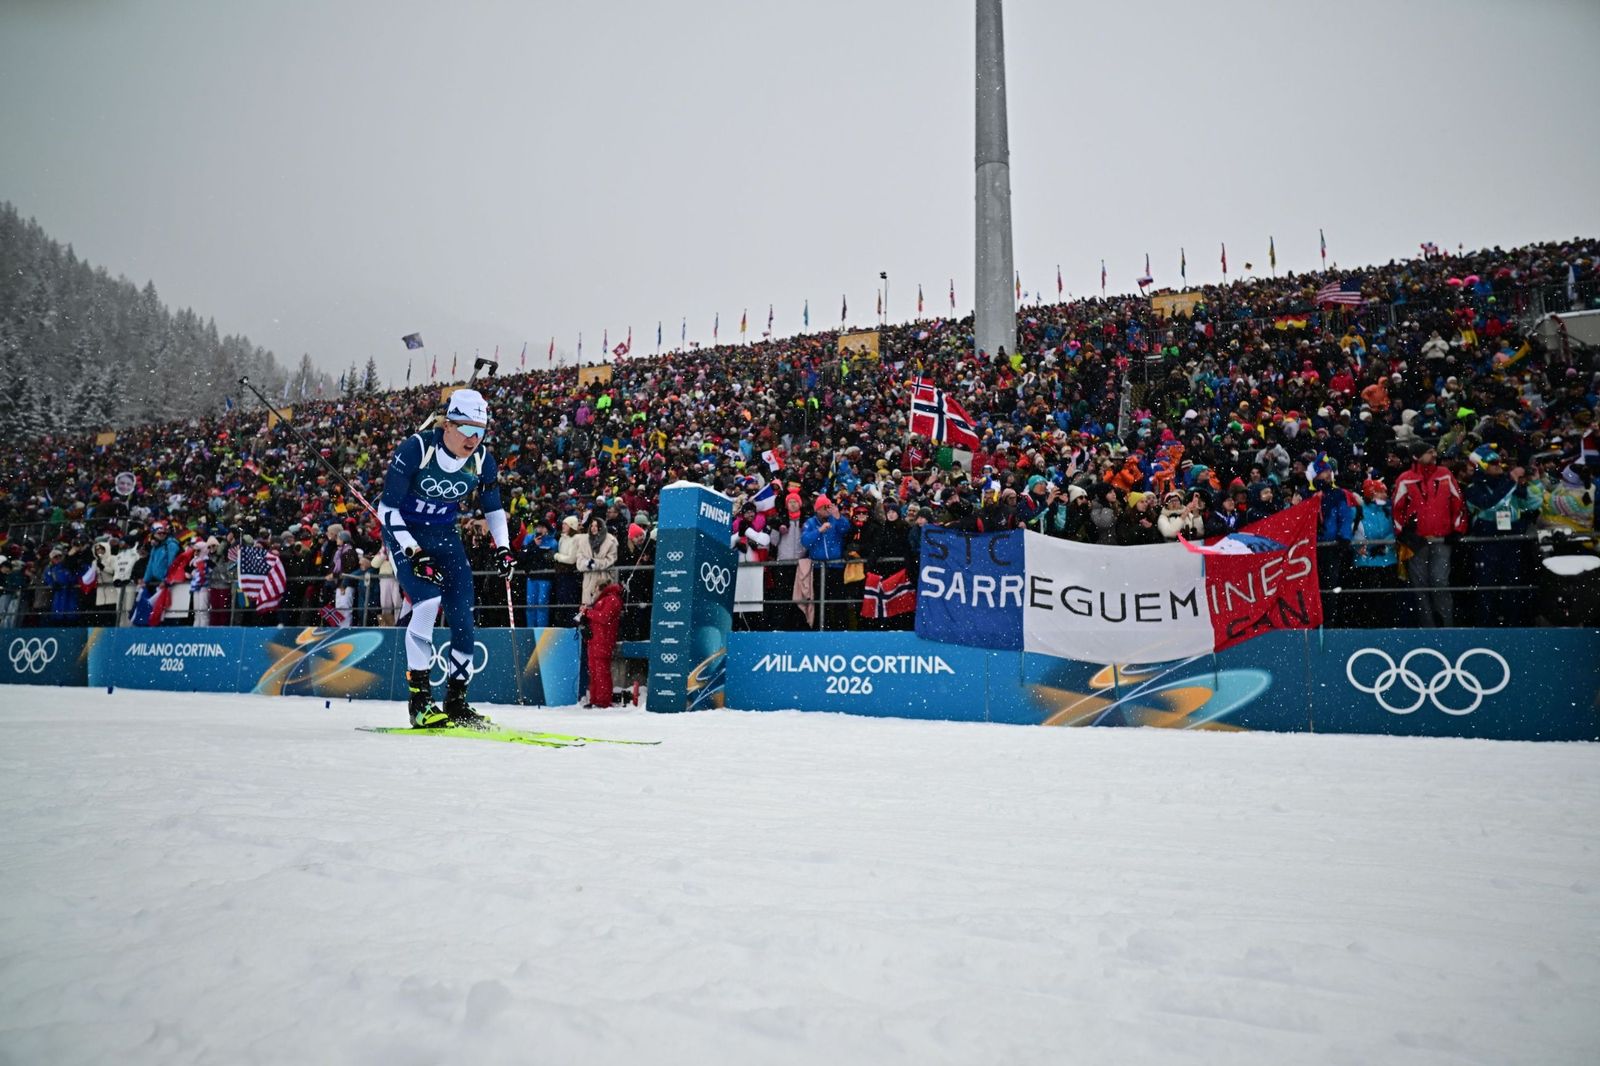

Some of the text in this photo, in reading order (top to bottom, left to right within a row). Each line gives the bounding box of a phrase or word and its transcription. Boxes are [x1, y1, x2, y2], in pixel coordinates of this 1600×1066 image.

[700, 502, 730, 525] FINISH
[924, 529, 1012, 567] STC
[920, 538, 1312, 622] SARREGUEMINES
[125, 642, 226, 657] MILANO CORTINA
[160, 658, 185, 672] 2026
[752, 654, 956, 674] MILANO CORTINA
[826, 675, 873, 695] 2026
